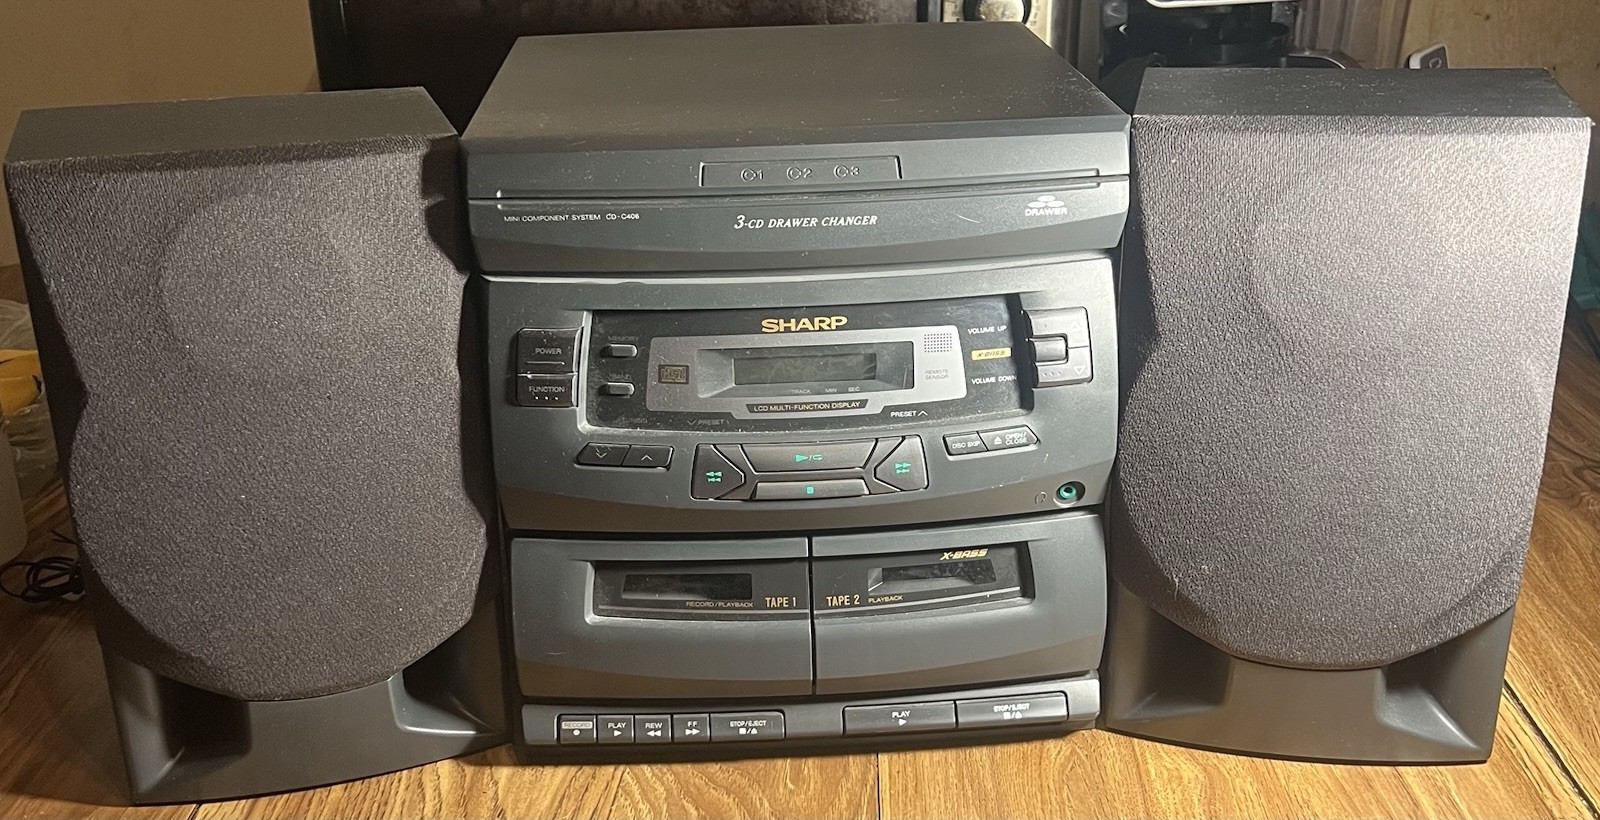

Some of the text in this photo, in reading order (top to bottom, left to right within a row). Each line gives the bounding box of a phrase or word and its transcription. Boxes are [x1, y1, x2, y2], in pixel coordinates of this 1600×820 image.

[1025, 207, 1068, 217] DRAWER
[733, 214, 878, 230] 3-CD DRAWER CHANGER
[761, 315, 849, 333] SHARP
[967, 327, 995, 335] VOLUME
[971, 375, 1017, 385] VOLUME DOWN
[770, 402, 831, 411] MULTI-FUNCTION
[831, 401, 861, 409] DISPLAY
[890, 410, 917, 418] PRESET
[697, 418, 725, 426] PRESET
[967, 440, 980, 448] SKIP
[940, 548, 989, 560] X-BASS
[765, 597, 797, 608] TAPE 1
[826, 595, 861, 607] TAPE 2
[868, 595, 904, 604] PLAYBACK
[892, 710, 911, 718] PLAY
